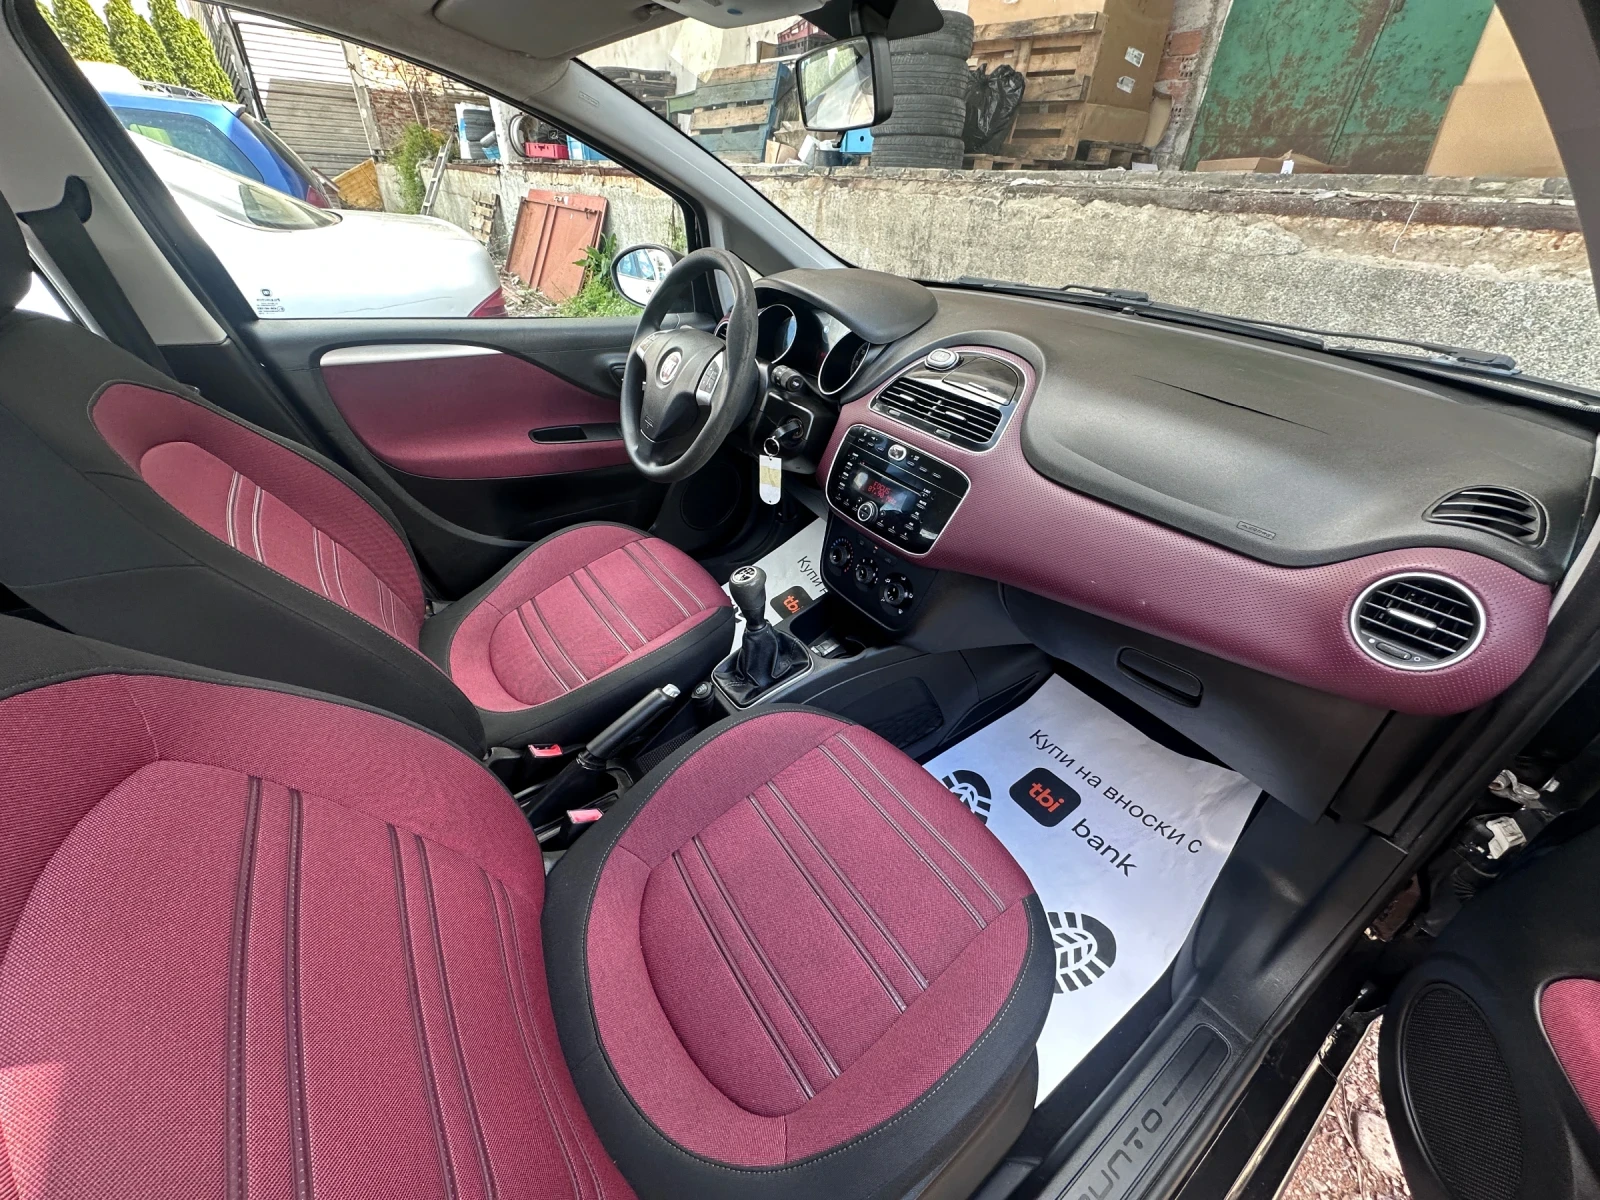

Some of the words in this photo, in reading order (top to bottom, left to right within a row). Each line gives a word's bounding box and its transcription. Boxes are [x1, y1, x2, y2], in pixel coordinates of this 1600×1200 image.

[873, 481, 891, 495] FOCUS
[797, 555, 823, 588] Купи
[1028, 782, 1065, 813] tbi
[1071, 818, 1138, 877] bank
[1029, 729, 1076, 768] Купи
[1075, 766, 1102, 789] на
[1102, 786, 1186, 845] вноски
[1187, 839, 1203, 854] с
[1078, 1108, 1163, 1200] UNTO
